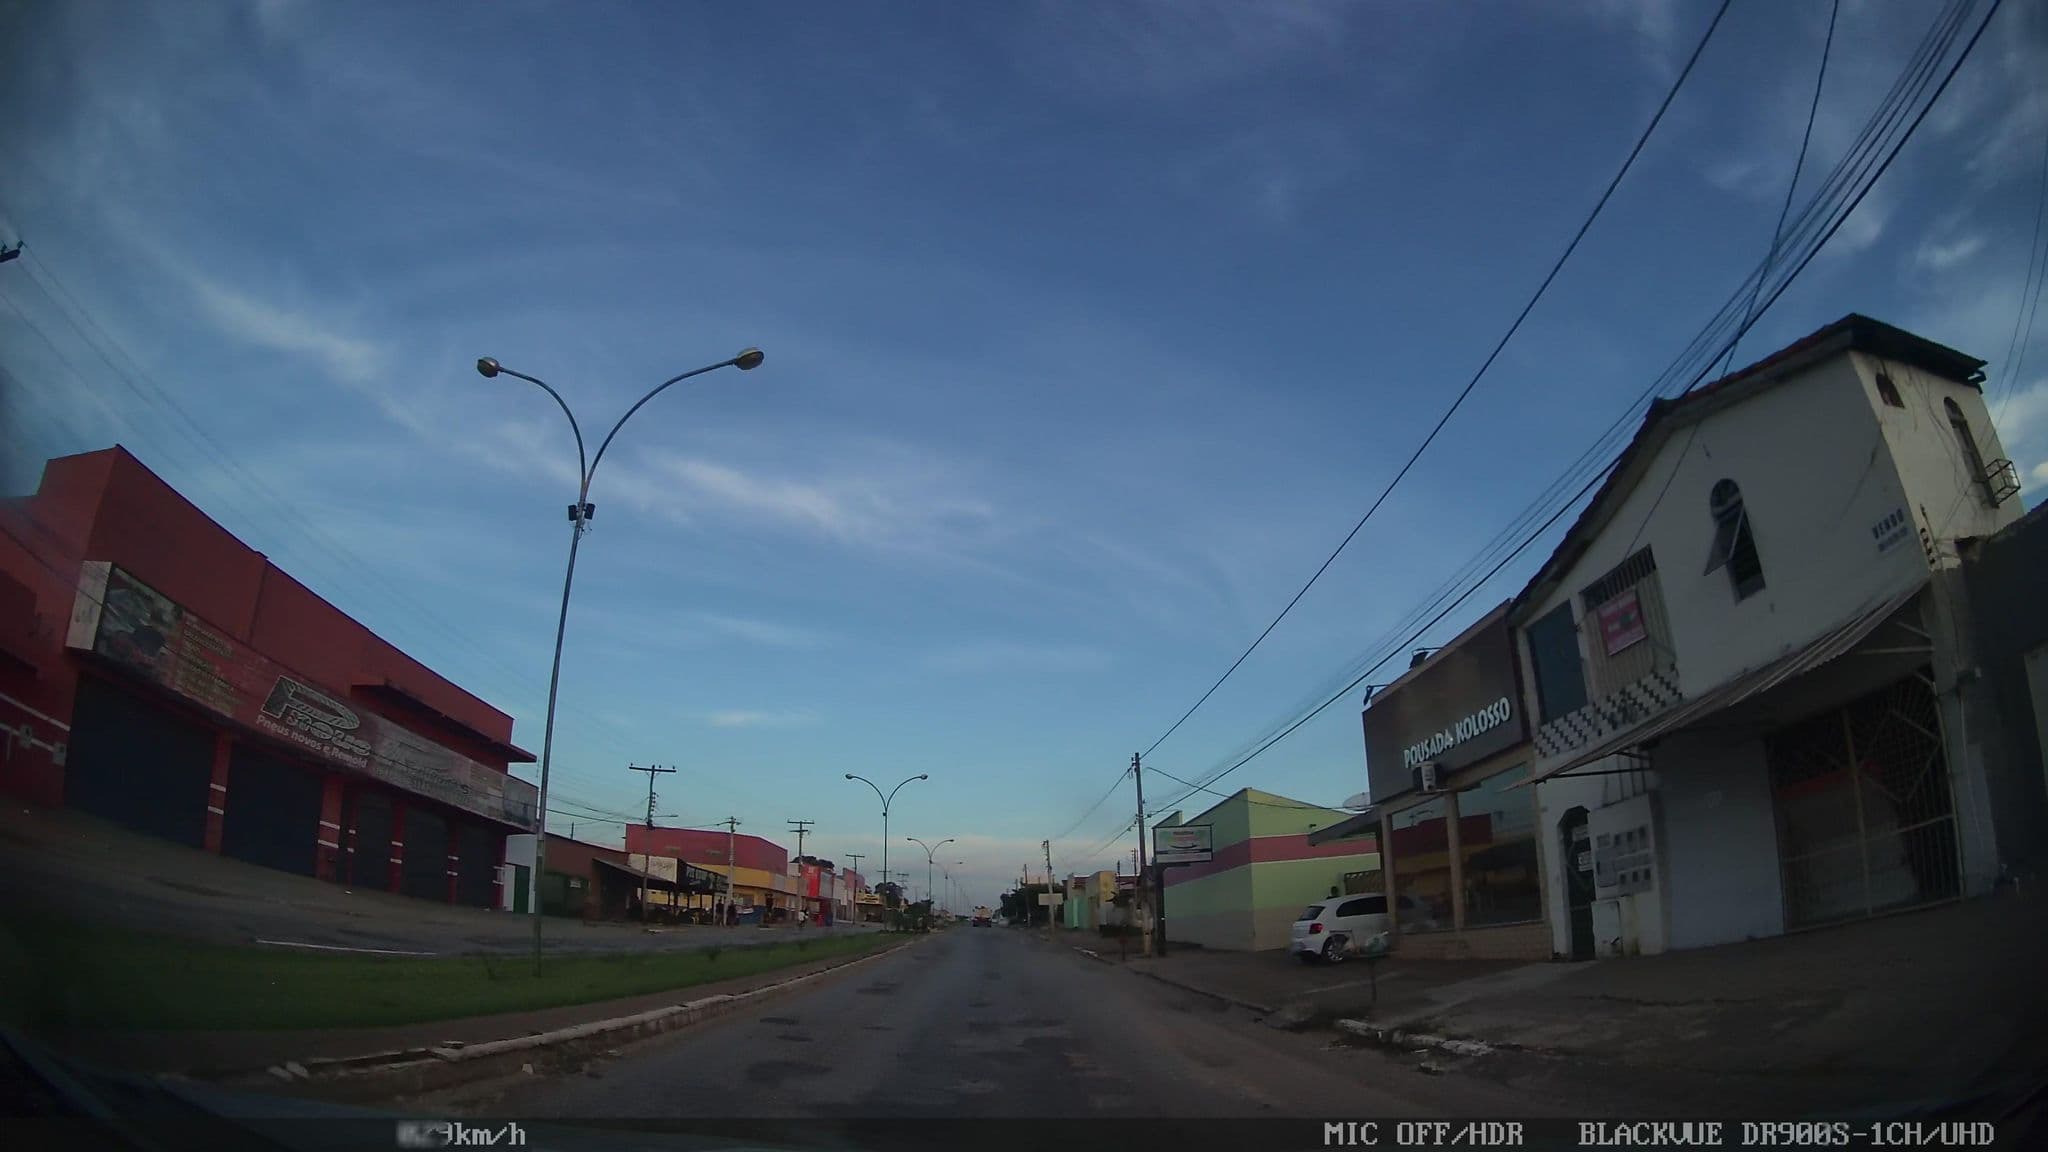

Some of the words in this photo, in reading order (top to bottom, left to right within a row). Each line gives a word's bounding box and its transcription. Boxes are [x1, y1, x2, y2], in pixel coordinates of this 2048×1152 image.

[256, 714, 290, 737] Pneus
[291, 730, 322, 752] novos
[1403, 728, 1454, 769] POUSADA
[1456, 696, 1512, 745] KOLOSSO
